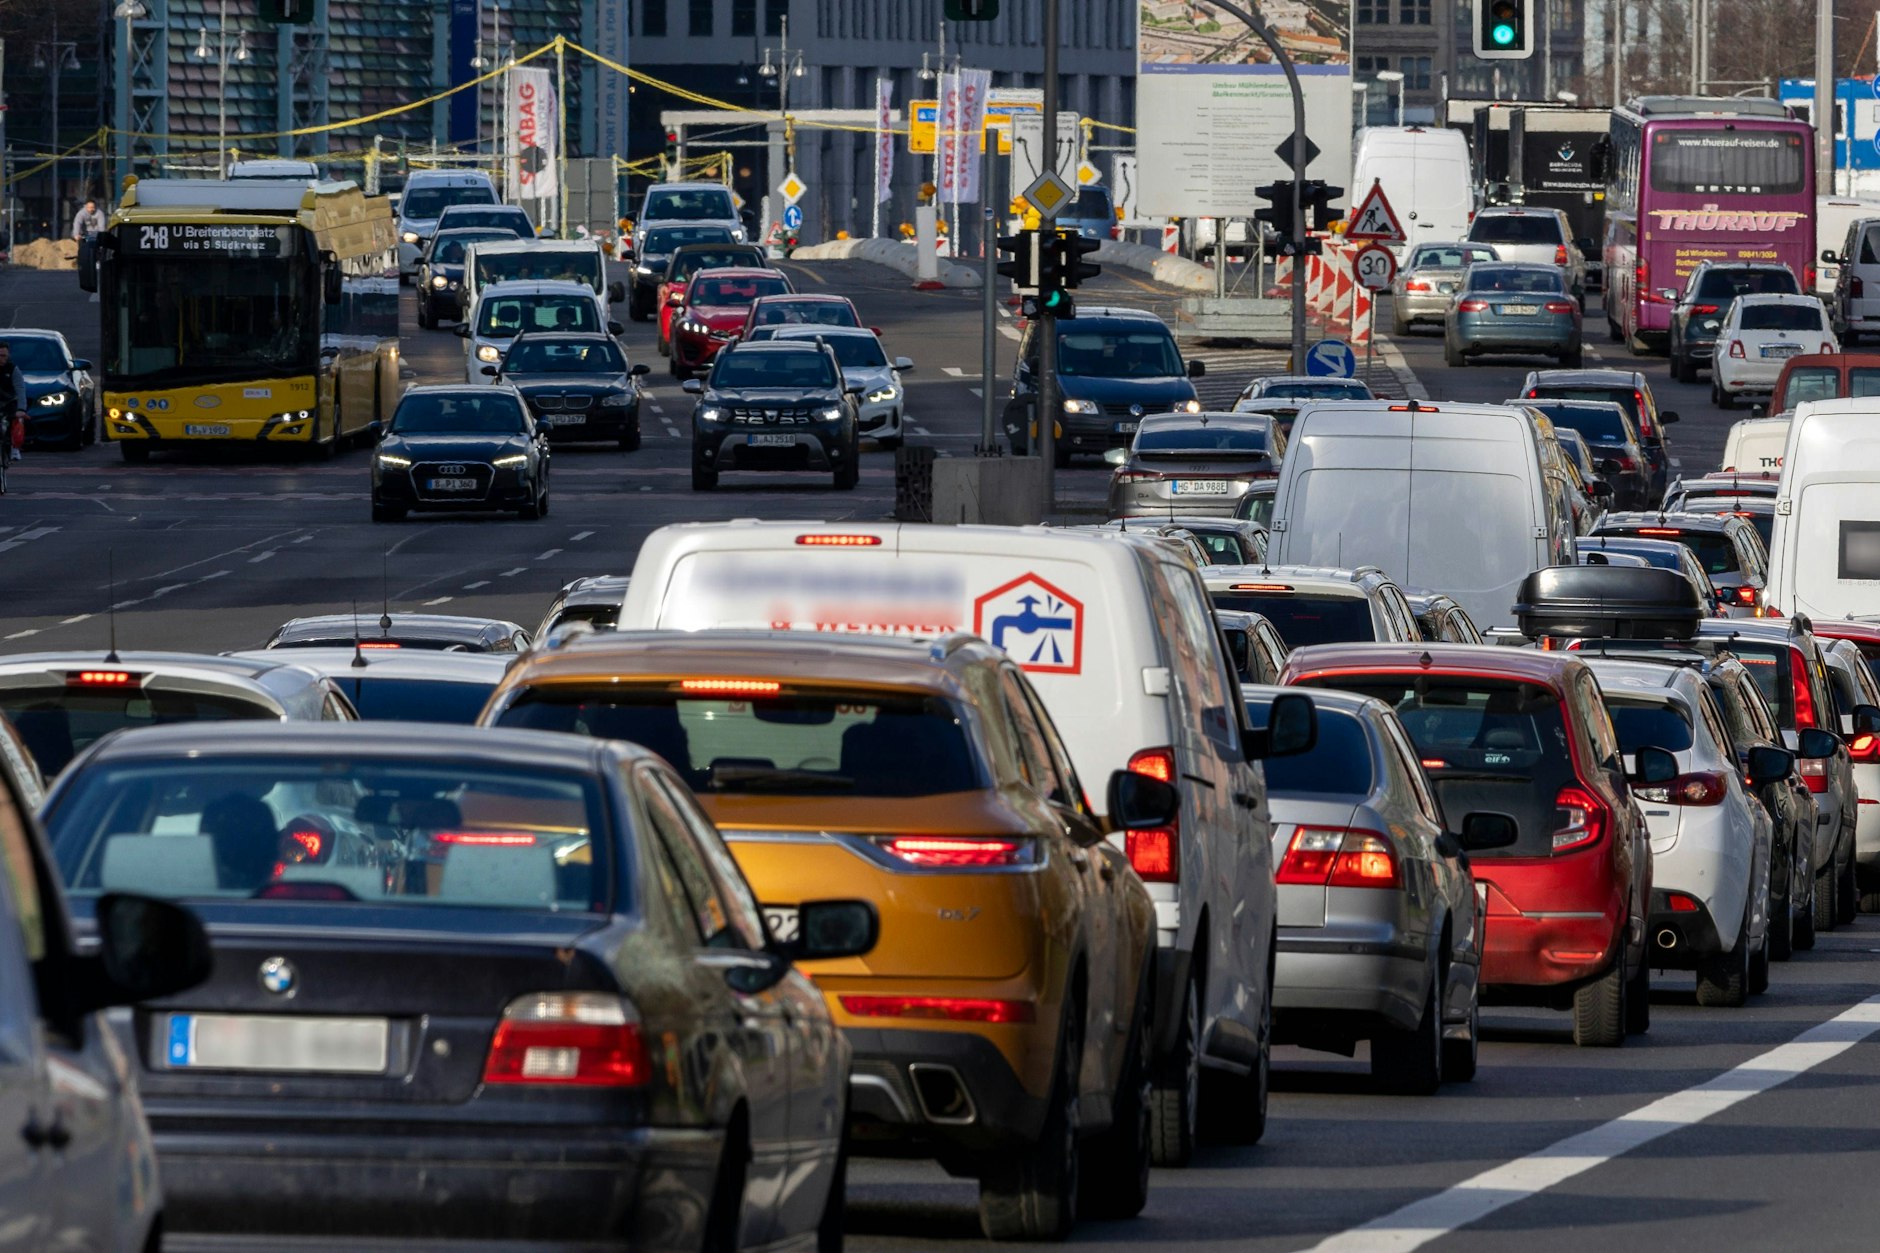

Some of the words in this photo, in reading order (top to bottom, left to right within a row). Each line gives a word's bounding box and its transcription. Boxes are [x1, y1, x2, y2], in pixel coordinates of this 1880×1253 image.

[518, 82, 536, 185] SABAG
[1678, 138, 1780, 148] www.thuerauf-reisen.de
[1695, 185, 1761, 193] SETRA
[1656, 204, 1799, 231] THÜRAUF
[140, 226, 168, 249] 248
[173, 226, 183, 238] U
[185, 226, 275, 239] Breitenbachplatz
[183, 240, 199, 249] via
[203, 241, 210, 249] S
[215, 240, 265, 249] Südkreuz
[1361, 256, 1387, 275] 30
[1178, 483, 1189, 491] HG
[1194, 482, 1204, 491] DA
